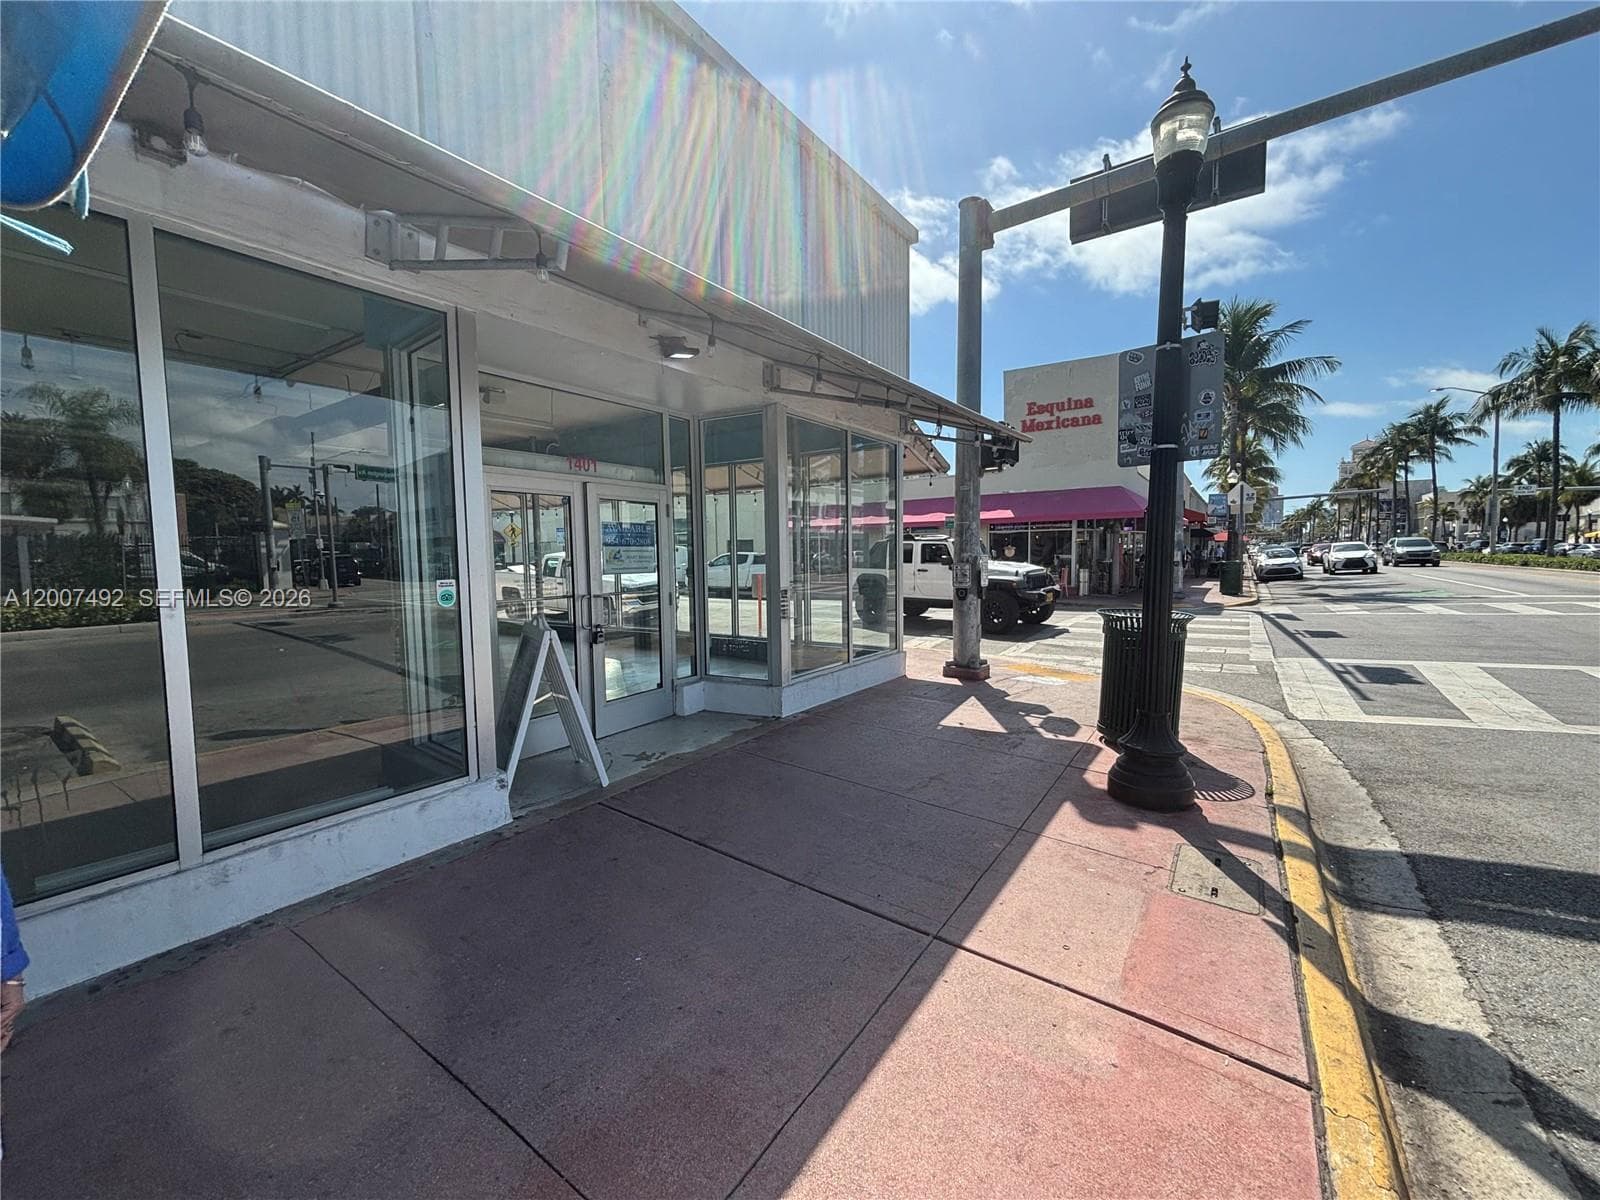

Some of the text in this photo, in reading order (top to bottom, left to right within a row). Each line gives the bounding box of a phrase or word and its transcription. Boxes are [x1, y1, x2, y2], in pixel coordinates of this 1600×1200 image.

[1026, 397, 1094, 416] Esquina
[1021, 414, 1102, 433] Mexicana
[565, 455, 597, 472] 1401
[606, 523, 652, 533] AVAILABLE
